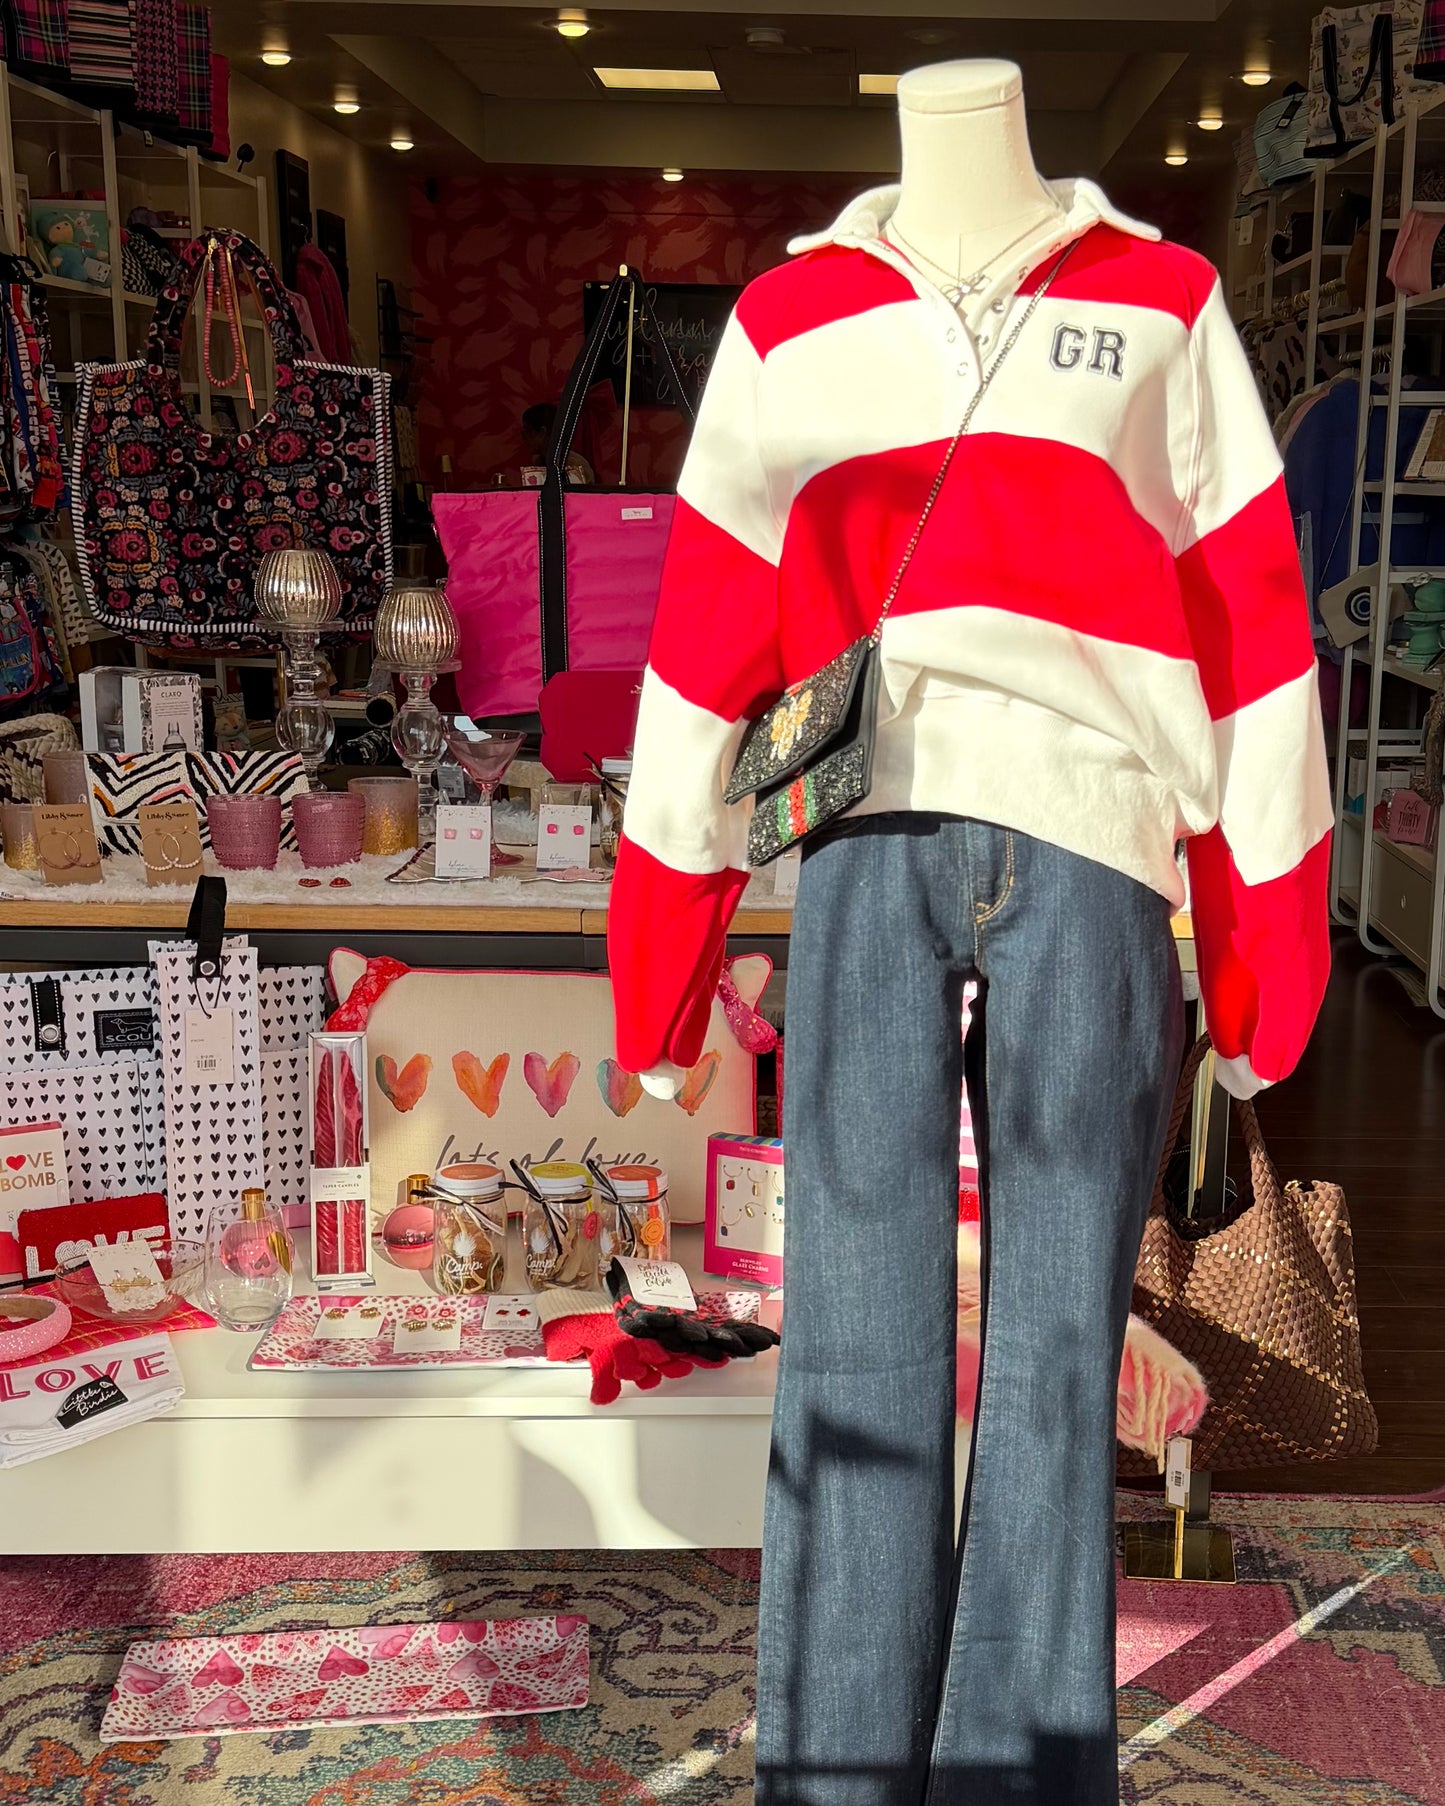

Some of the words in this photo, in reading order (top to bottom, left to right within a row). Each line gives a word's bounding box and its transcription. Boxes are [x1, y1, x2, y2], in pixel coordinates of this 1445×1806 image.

[1049, 321, 1127, 381] GR
[1, 1171, 57, 1192] BOMB
[0, 1351, 170, 1401] LOVE
[76, 1389, 119, 1416] Birdie
